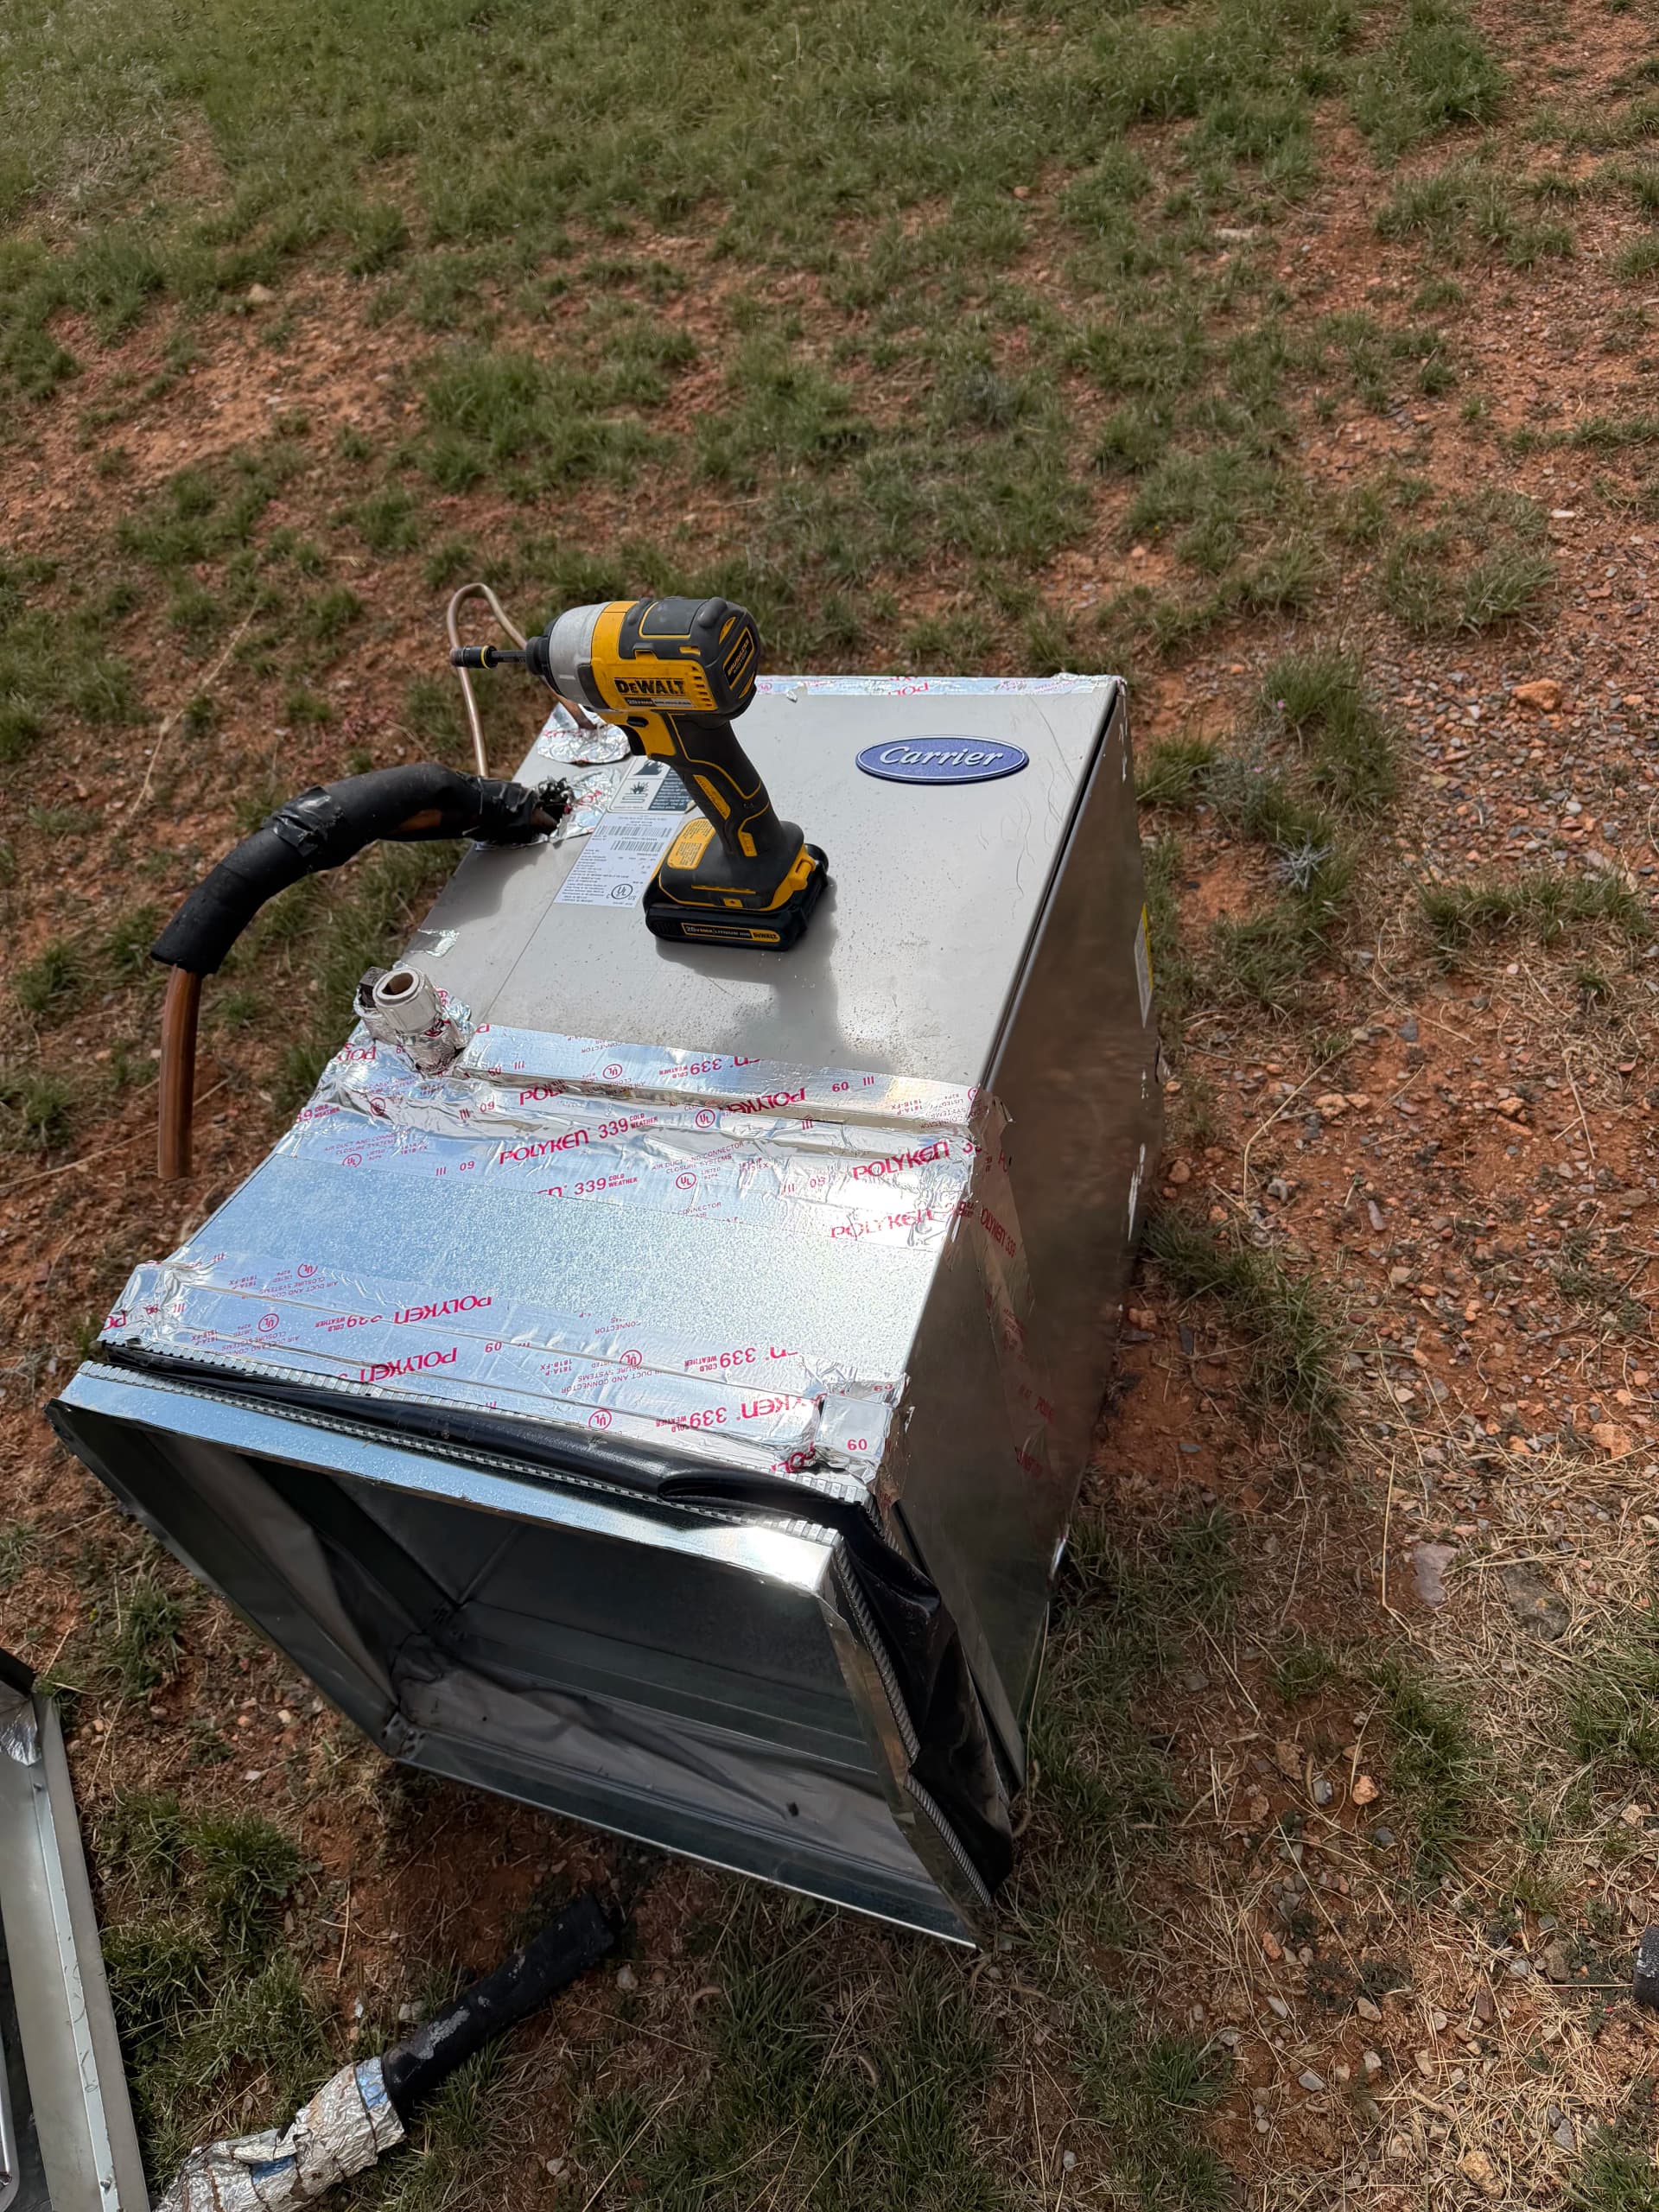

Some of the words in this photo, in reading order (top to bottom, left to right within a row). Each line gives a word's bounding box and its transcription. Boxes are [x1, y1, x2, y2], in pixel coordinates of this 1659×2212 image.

[880, 746, 1004, 767] Carrier
[690, 1058, 722, 1076] 339
[832, 1081, 849, 1093] 09
[480, 1101, 496, 1113] 09
[629, 1112, 645, 1122] COLD
[630, 1116, 658, 1128] WEATHER
[335, 1141, 353, 1150] DUCT
[499, 1129, 590, 1165] POLYKEN
[598, 1117, 629, 1140] 339
[335, 1145, 365, 1155] CLOSURE
[664, 1160, 683, 1169] DUCT
[703, 1141, 744, 1159] CONNECTOR
[665, 1163, 696, 1174] CLOSURE
[700, 1154, 733, 1166] SYSTEMS
[852, 1140, 950, 1180] POLYKEN
[460, 1161, 474, 1172] 09
[701, 1166, 721, 1175] LISTED
[607, 1177, 638, 1189] WEATHER
[608, 1173, 626, 1182] COLD
[574, 1178, 607, 1196] 339
[981, 1205, 1006, 1247] OLYKEN
[307, 1284, 325, 1293] DUCT
[393, 1295, 492, 1325] POLYKEN
[315, 1316, 346, 1328] WEATHER
[327, 1323, 345, 1332] COLD
[485, 1341, 503, 1353] 09
[683, 1355, 717, 1368] WEATHER
[720, 1347, 757, 1369] 339
[359, 1347, 458, 1382] POLYKEN
[699, 1363, 717, 1372] COLD
[578, 1371, 614, 1382] SYSTEMS
[612, 1374, 630, 1383] AND
[562, 1379, 609, 1394] CONNECTOR
[689, 1407, 728, 1428] 339
[847, 1439, 868, 1451] 09
